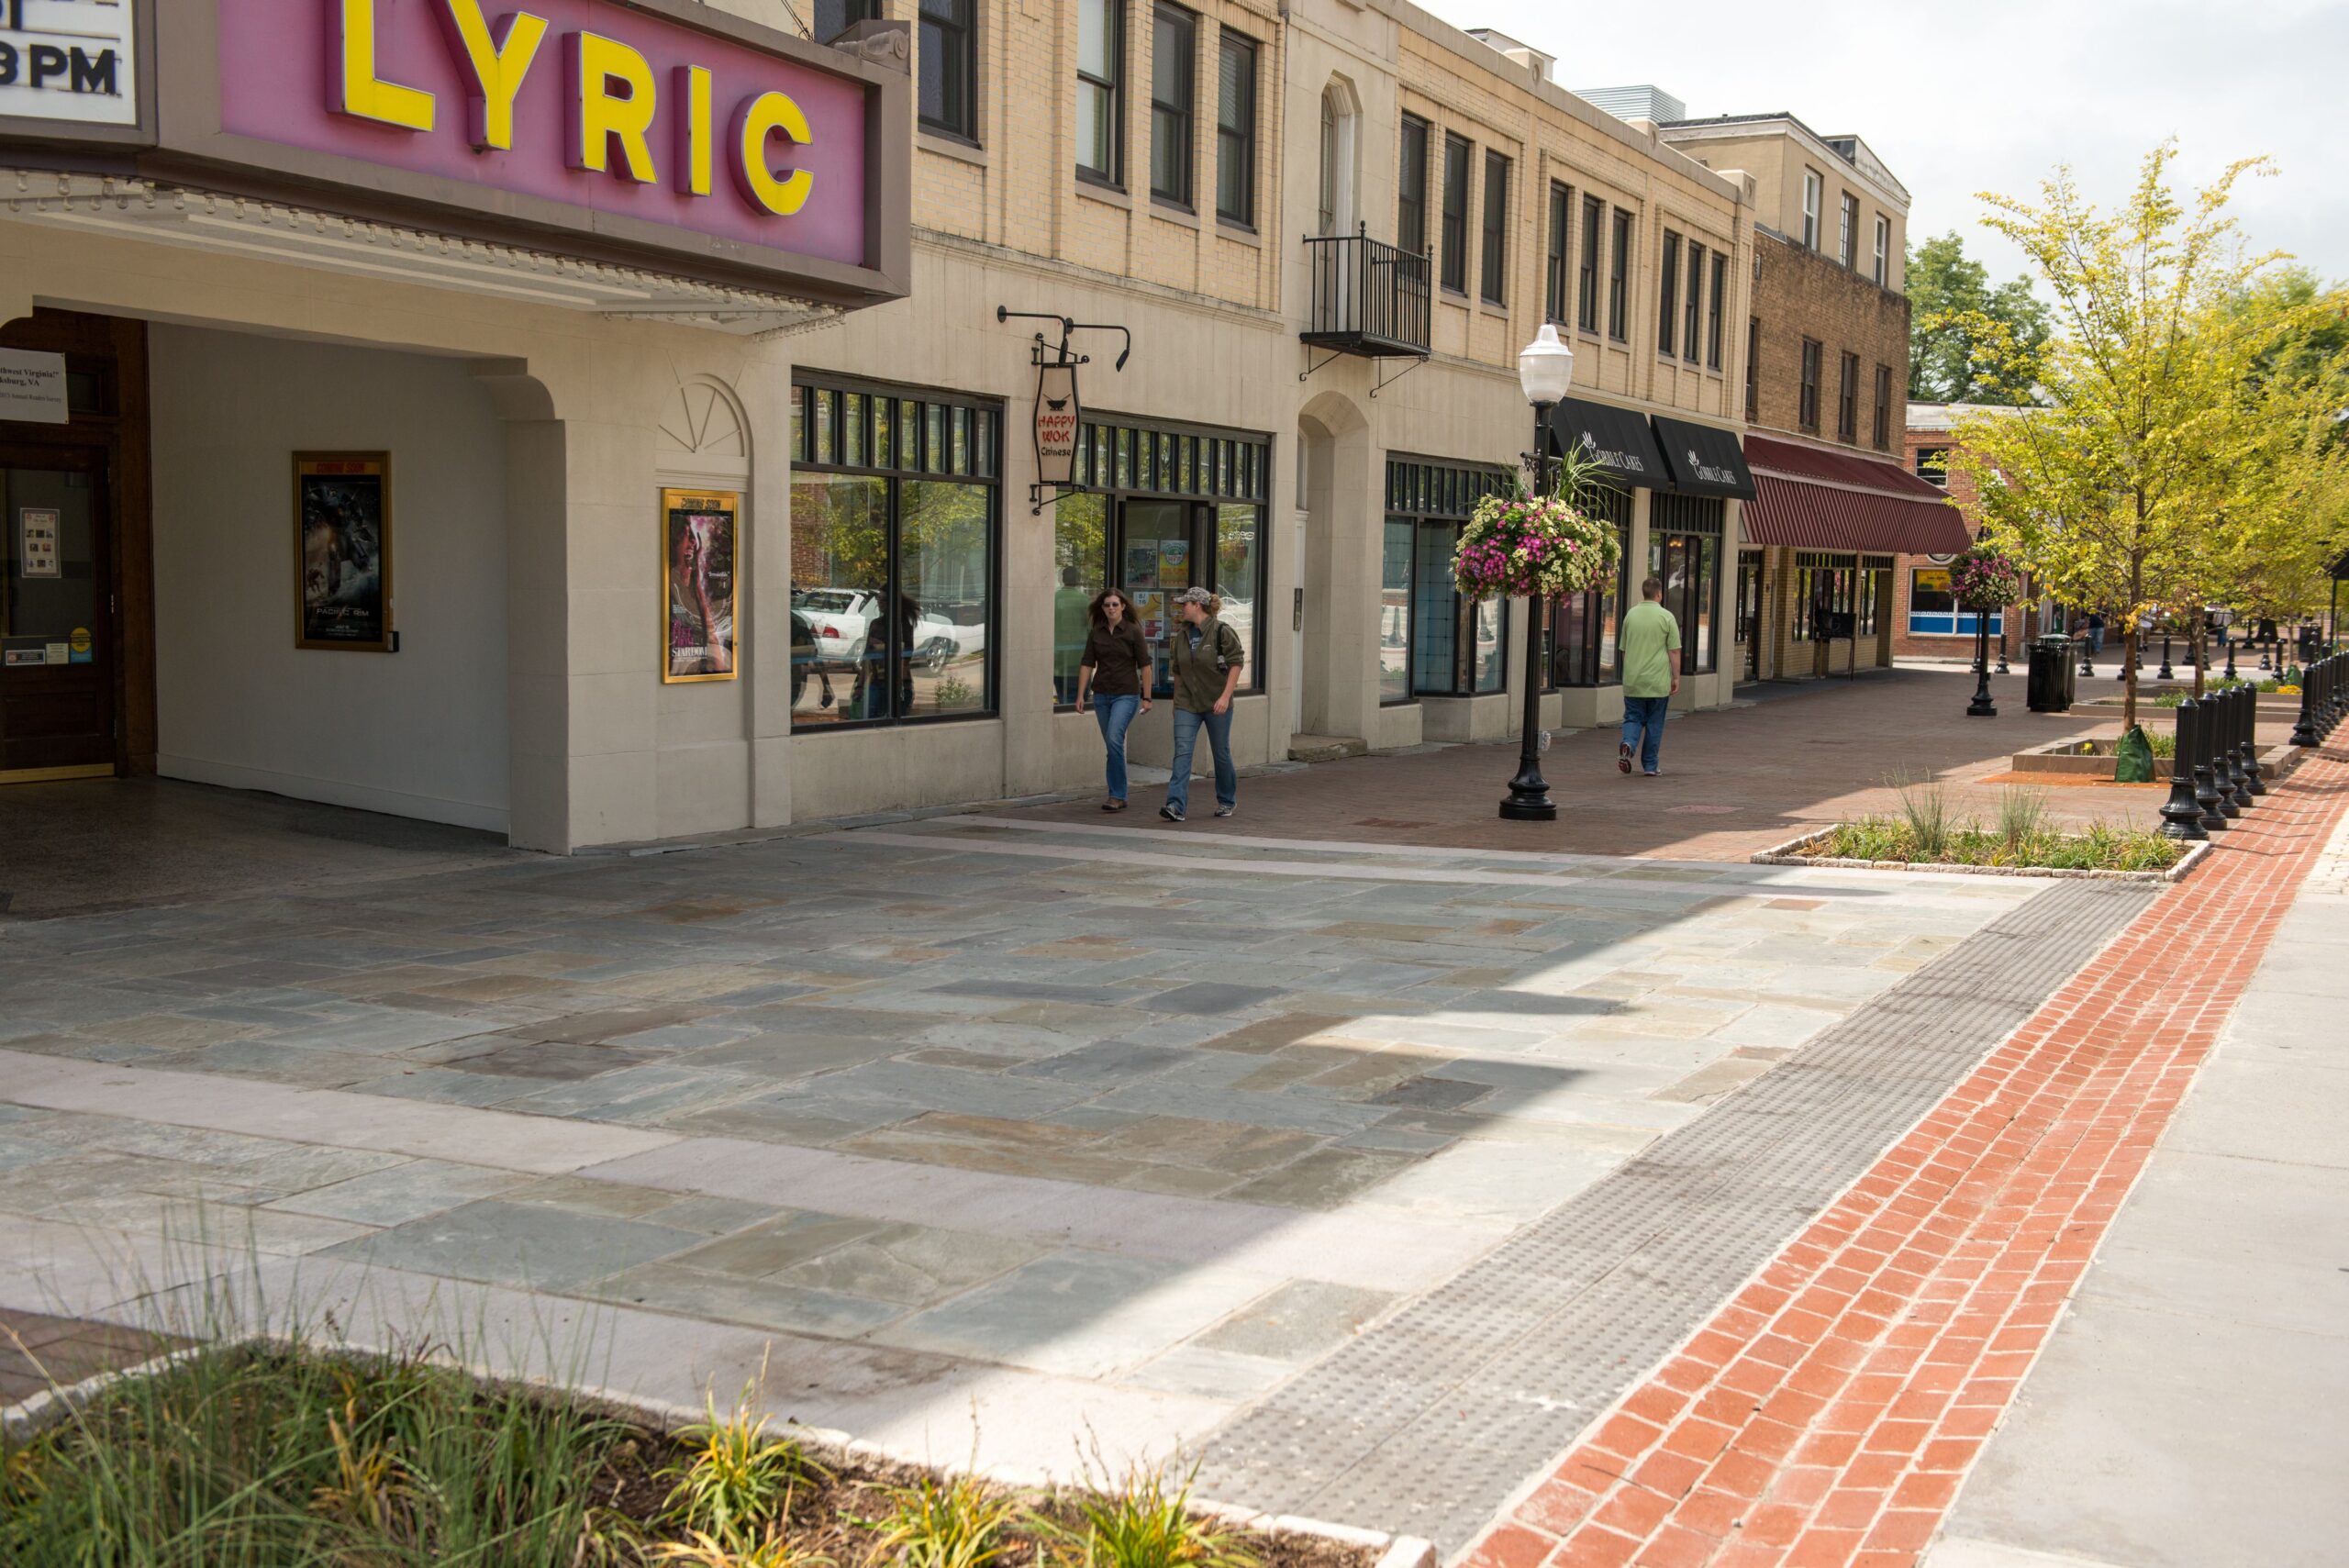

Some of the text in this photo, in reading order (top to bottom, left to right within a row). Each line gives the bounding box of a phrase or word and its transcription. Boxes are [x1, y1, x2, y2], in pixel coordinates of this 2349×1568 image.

[328, 0, 814, 216] LYRIC
[28, 378, 39, 386] VA
[1038, 416, 1075, 428] HAPPY
[1042, 430, 1070, 441] WOK
[1041, 447, 1072, 457] Chinese
[672, 646, 707, 657] STARDOM
